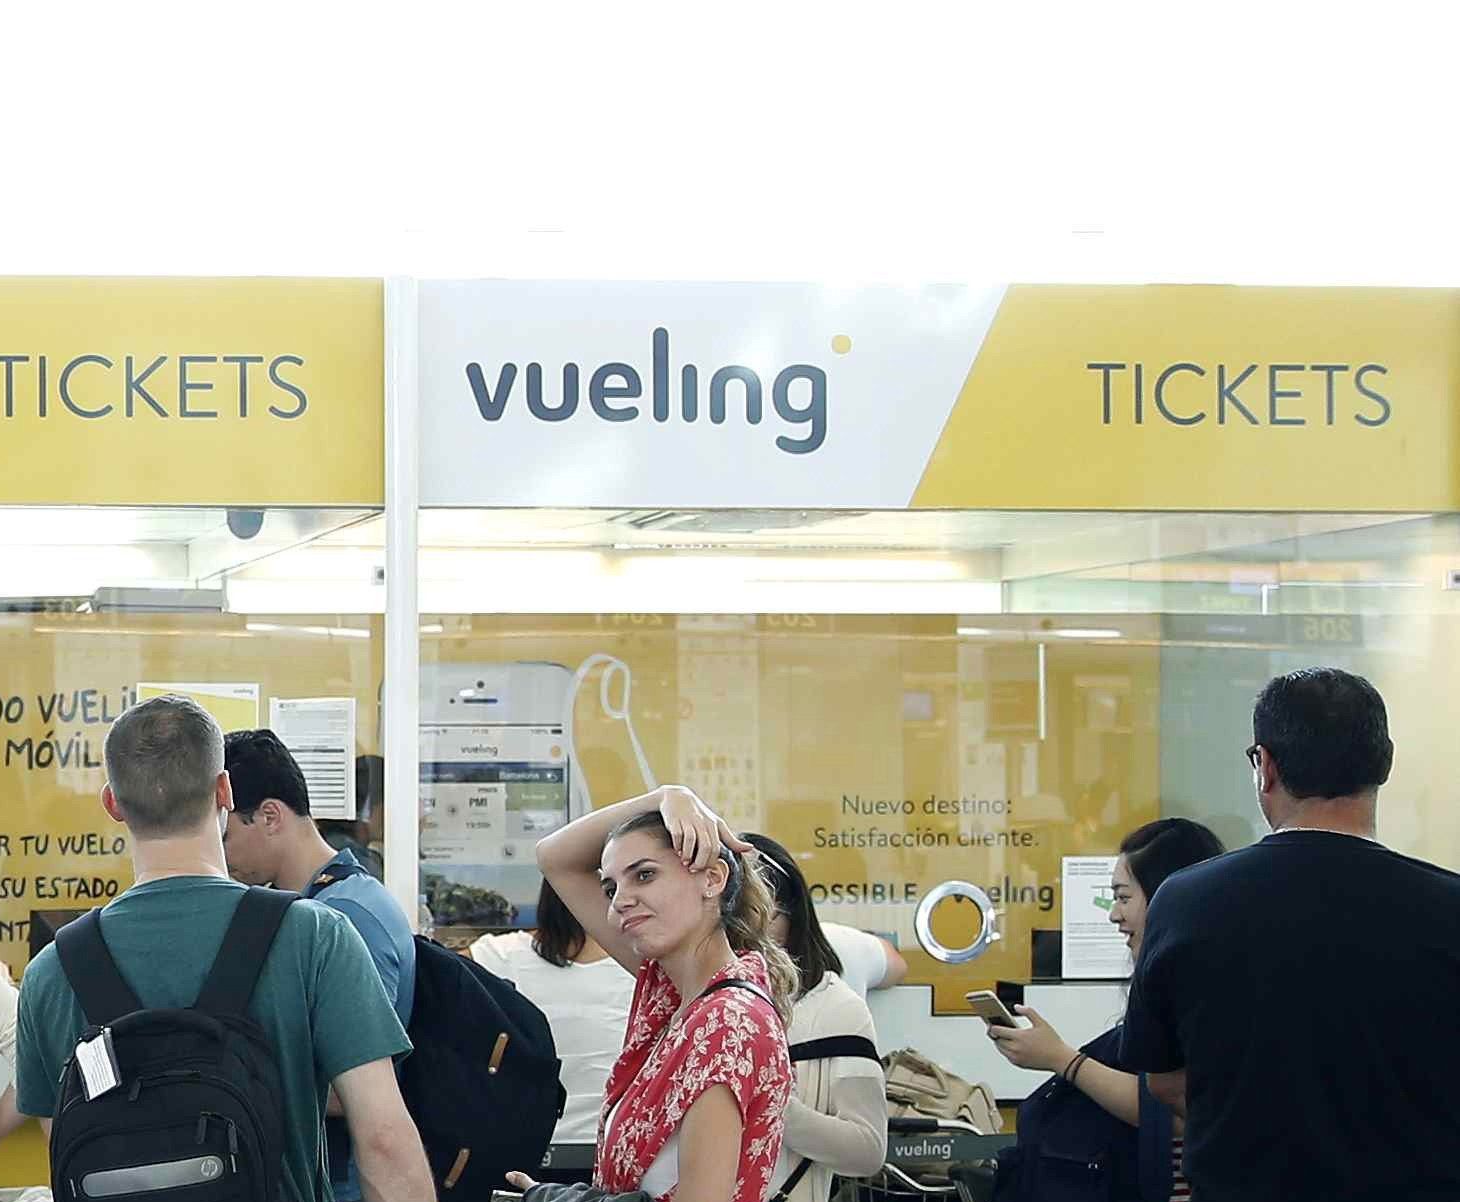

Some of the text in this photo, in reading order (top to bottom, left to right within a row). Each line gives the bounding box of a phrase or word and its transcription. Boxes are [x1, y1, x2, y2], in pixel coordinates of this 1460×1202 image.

[466, 327, 1391, 454] vueling TICKETS
[841, 794, 1013, 816] Nuevo destino:
[19, 834, 50, 856] TU
[57, 833, 126, 856] VUELO
[813, 826, 1041, 849] Satisfacción cliente.
[34, 876, 119, 900] ESTADO
[808, 882, 918, 906] OSSIBLE
[895, 1139, 956, 1163] vueling
